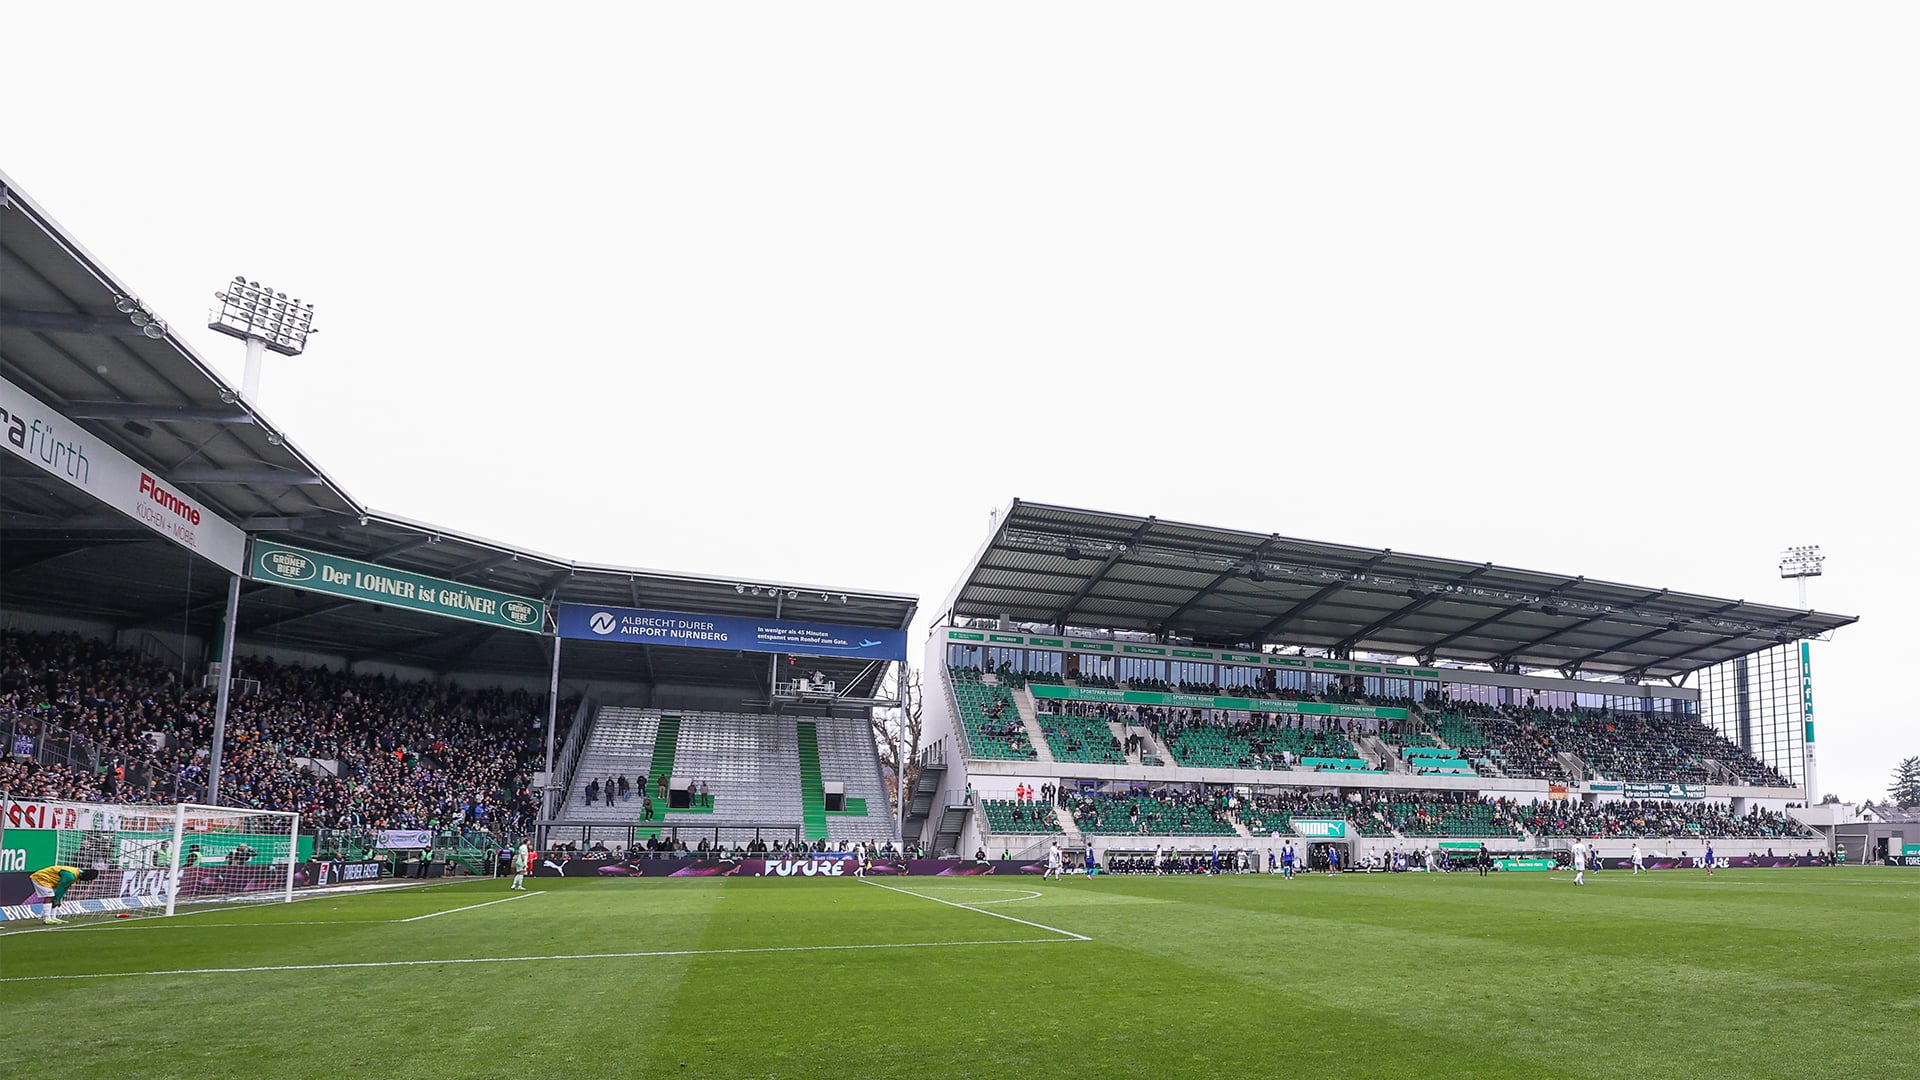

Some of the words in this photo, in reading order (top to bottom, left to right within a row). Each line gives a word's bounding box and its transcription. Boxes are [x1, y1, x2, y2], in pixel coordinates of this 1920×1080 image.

[139, 472, 201, 526] Flamme
[136, 501, 166, 529] KÜCHEN
[173, 523, 197, 548] MÖBEL
[277, 563, 301, 577] BIERE
[322, 565, 351, 586] Der
[355, 572, 416, 599] LOHNER
[418, 585, 436, 603] ist
[439, 589, 497, 616] GRÜNER!
[621, 616, 676, 628] ALBRECHT
[620, 626, 668, 637] AIRPORT
[764, 627, 788, 635] weniger
[1803, 662, 1813, 722] infra
[1294, 822, 1329, 835] PUMA
[765, 860, 845, 876] FUTURE
[1692, 857, 1730, 868] FUURE
